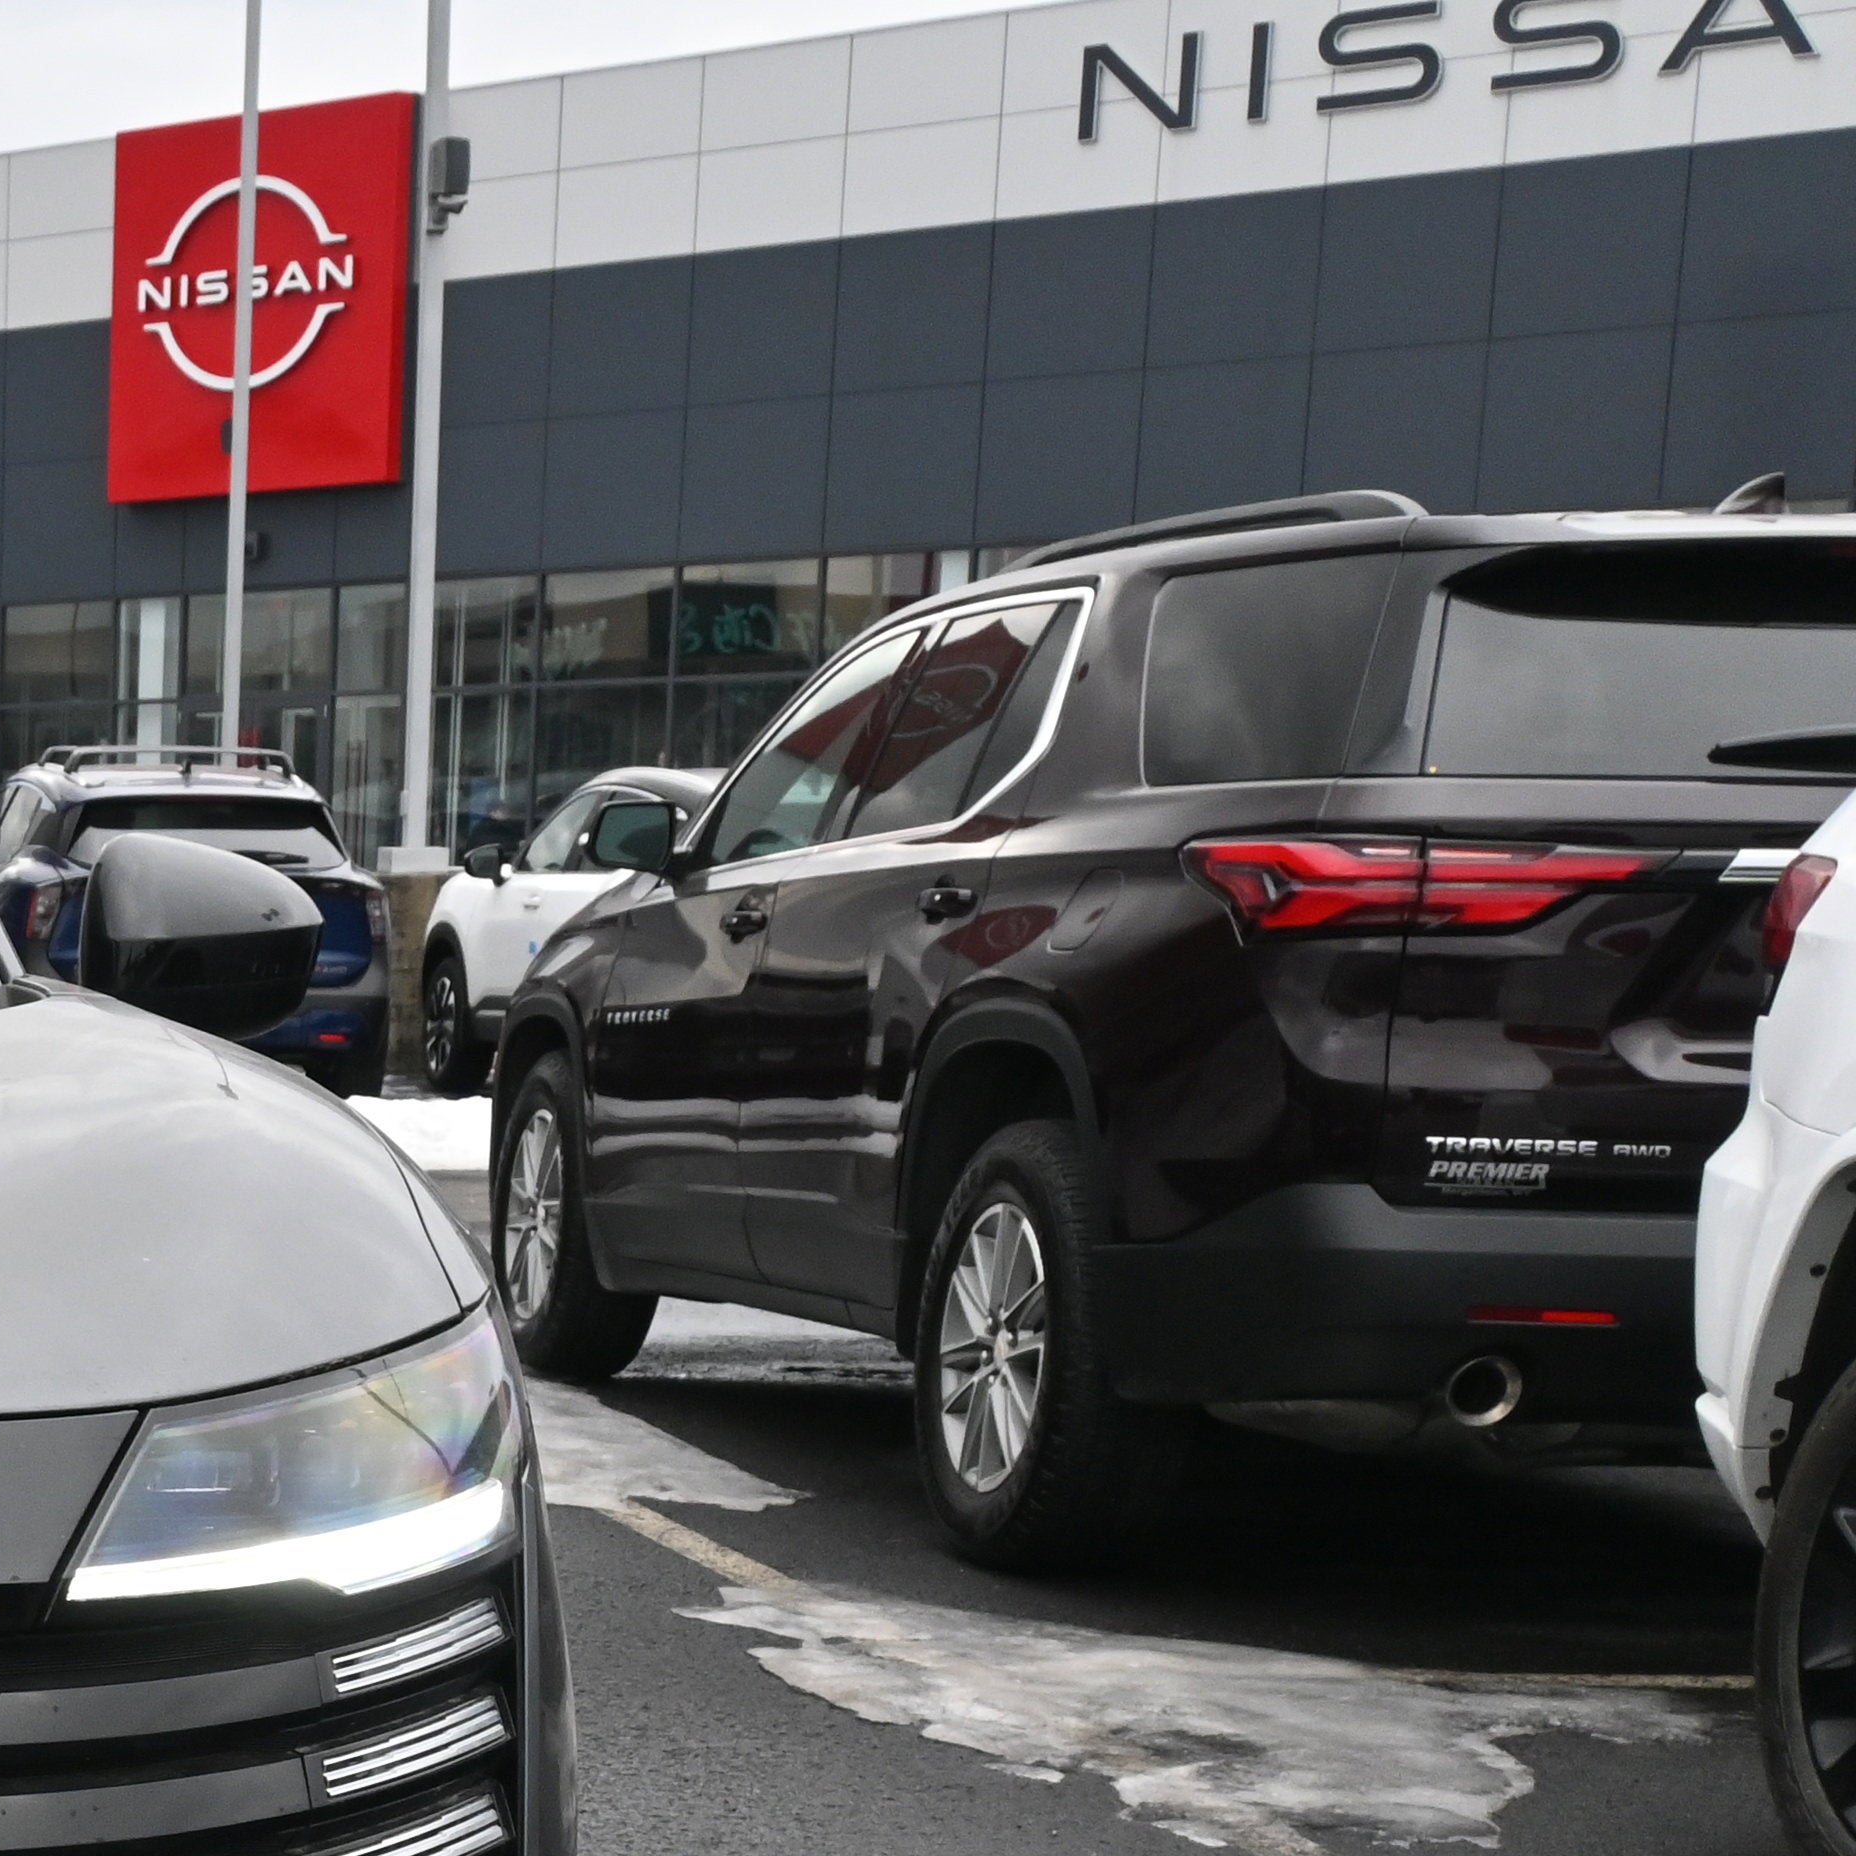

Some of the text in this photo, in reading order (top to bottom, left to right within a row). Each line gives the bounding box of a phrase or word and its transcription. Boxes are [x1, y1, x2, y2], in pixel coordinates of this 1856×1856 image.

[1077, 0, 1820, 143] NISSA
[138, 254, 354, 313] NISSAN
[1425, 1136, 1672, 1159] TRAVERSE AWD
[1428, 1160, 1550, 1183] PREMIER
